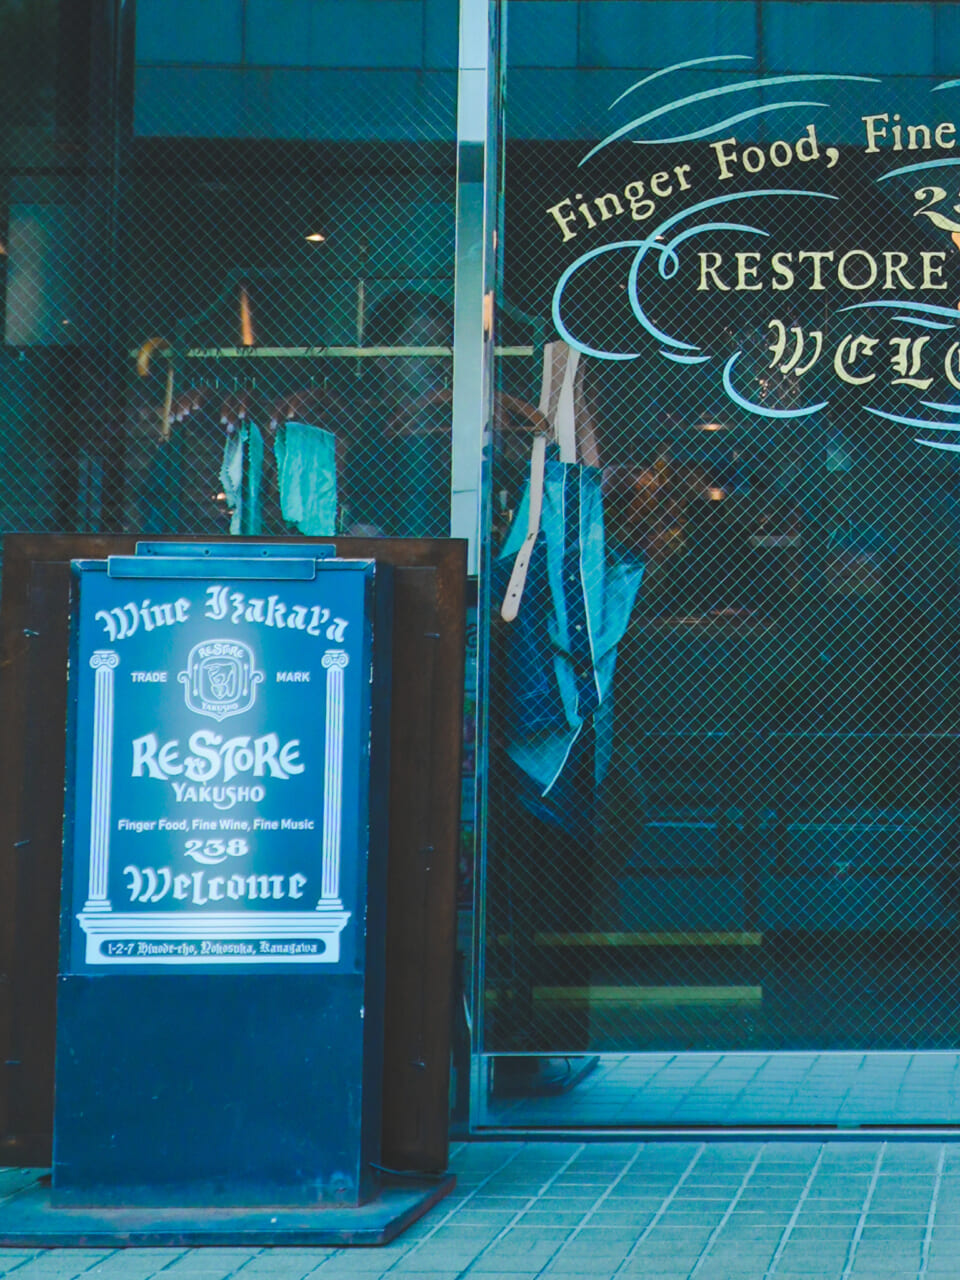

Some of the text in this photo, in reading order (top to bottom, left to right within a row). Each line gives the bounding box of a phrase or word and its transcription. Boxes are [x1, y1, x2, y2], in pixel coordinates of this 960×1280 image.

[545, 161, 692, 242] Finger
[709, 124, 840, 180] Food,
[862, 112, 957, 155] Fine
[697, 249, 950, 291] RESTORE
[94, 584, 349, 643] Wine Izakaya
[130, 671, 311, 683] TRADE MARK
[171, 781, 265, 811] YAKUSHO
[118, 818, 315, 833] Finger Food, Fine Wine, Fine Music
[184, 838, 249, 865] 238
[123, 864, 307, 906] Welcome
[108, 943, 135, 955] 1-2-7
[259, 939, 318, 955] Kanagawa
